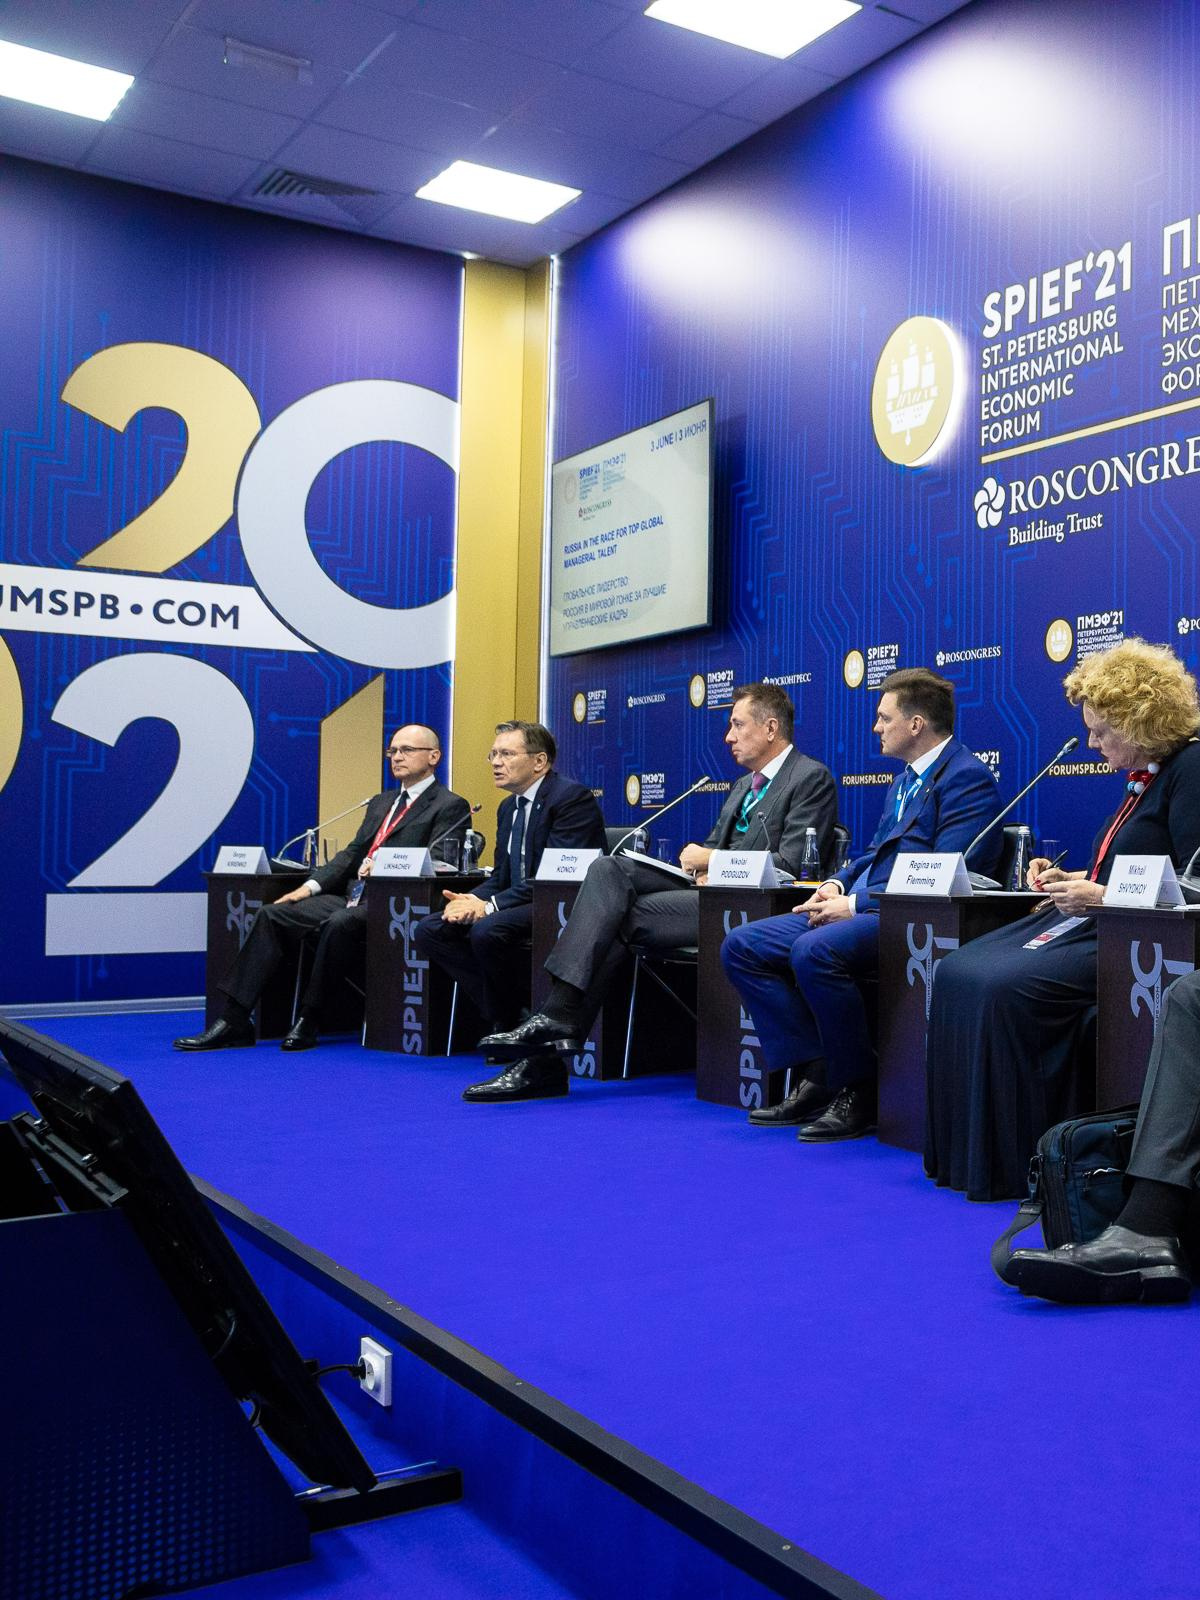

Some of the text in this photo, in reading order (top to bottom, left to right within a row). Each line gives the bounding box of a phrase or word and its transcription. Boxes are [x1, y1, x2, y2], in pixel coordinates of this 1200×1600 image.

[982, 242, 1133, 340] SPIEF'21
[981, 305, 1118, 369] ST. PETERSBURG
[981, 332, 1124, 394] INTERNATIONAL
[981, 373, 1074, 422] ECONOMIC
[981, 410, 1041, 447] FORUM
[656, 432, 674, 450] JUNE
[564, 515, 664, 554] RUSSIA IN THE RACE FOR TOP GLOBAL
[1009, 511, 1103, 547] Building Trust
[564, 544, 618, 569] MANAGERIAL TALENT
[1077, 610, 1123, 630] ПМЭФ'21
[1077, 626, 1117, 638] ПЕТЕРБУРГСКИЙ
[1077, 631, 1124, 645] МЕЖДУНАРОДНЫЙ
[868, 644, 899, 660] SPIEF'21
[945, 646, 1001, 664] ROSCONGRESS
[842, 774, 893, 785] FORUMSPB.COM
[909, 860, 929, 871] Regina
[906, 874, 936, 888] Flemming
